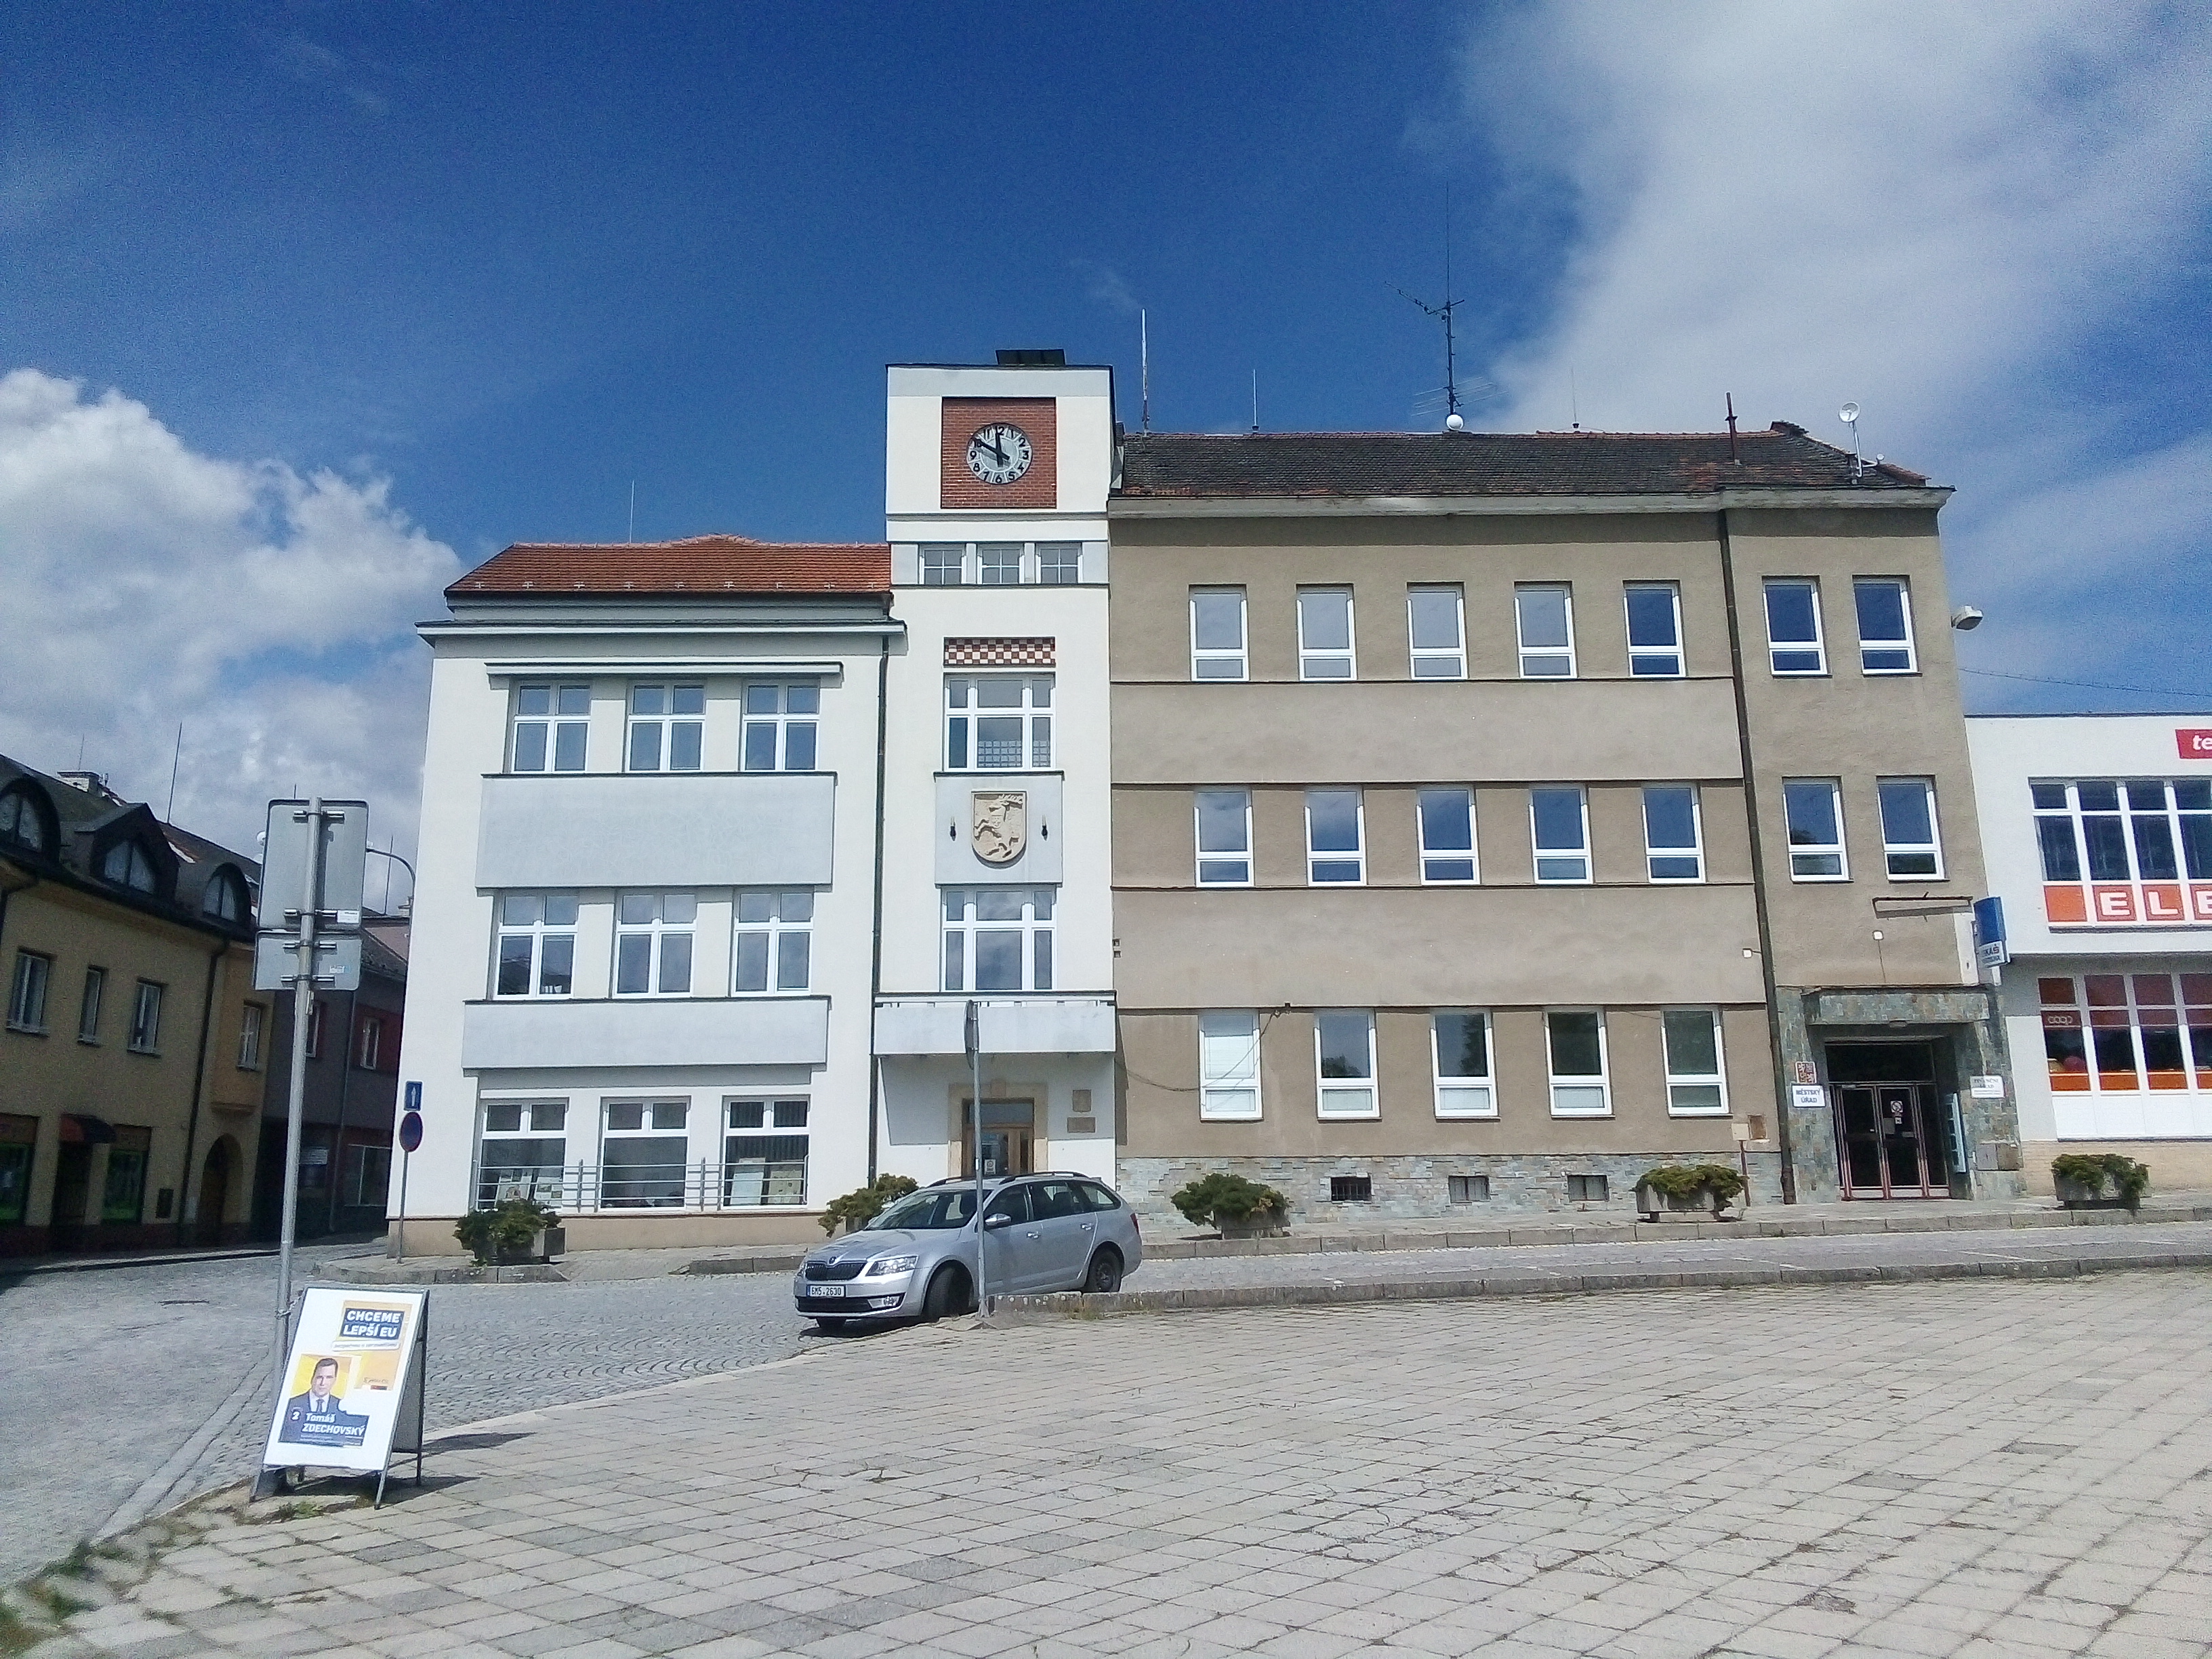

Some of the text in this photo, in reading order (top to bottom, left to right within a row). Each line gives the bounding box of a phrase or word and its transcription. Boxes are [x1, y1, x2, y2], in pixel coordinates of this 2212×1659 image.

[983, 429, 990, 439] 11
[995, 426, 1004, 436] 12
[1010, 430, 1014, 438] 1
[1019, 437, 1026, 447] 2
[970, 451, 977, 459] 9
[1022, 450, 1029, 459] 3
[973, 463, 980, 472] 8
[1017, 462, 1024, 472] 4
[983, 471, 990, 481] 7
[996, 474, 1002, 483] 6
[1008, 472, 1015, 480] 5
[2192, 735, 2212, 750] te
[347, 1310, 401, 1323] CHCEME
[343, 1323, 398, 1337] LEPŠÍ EU
[292, 1411, 299, 1420] 2
[306, 1413, 335, 1422] Tomáš
[302, 1423, 365, 1436] ZDECHOVSKÝ
